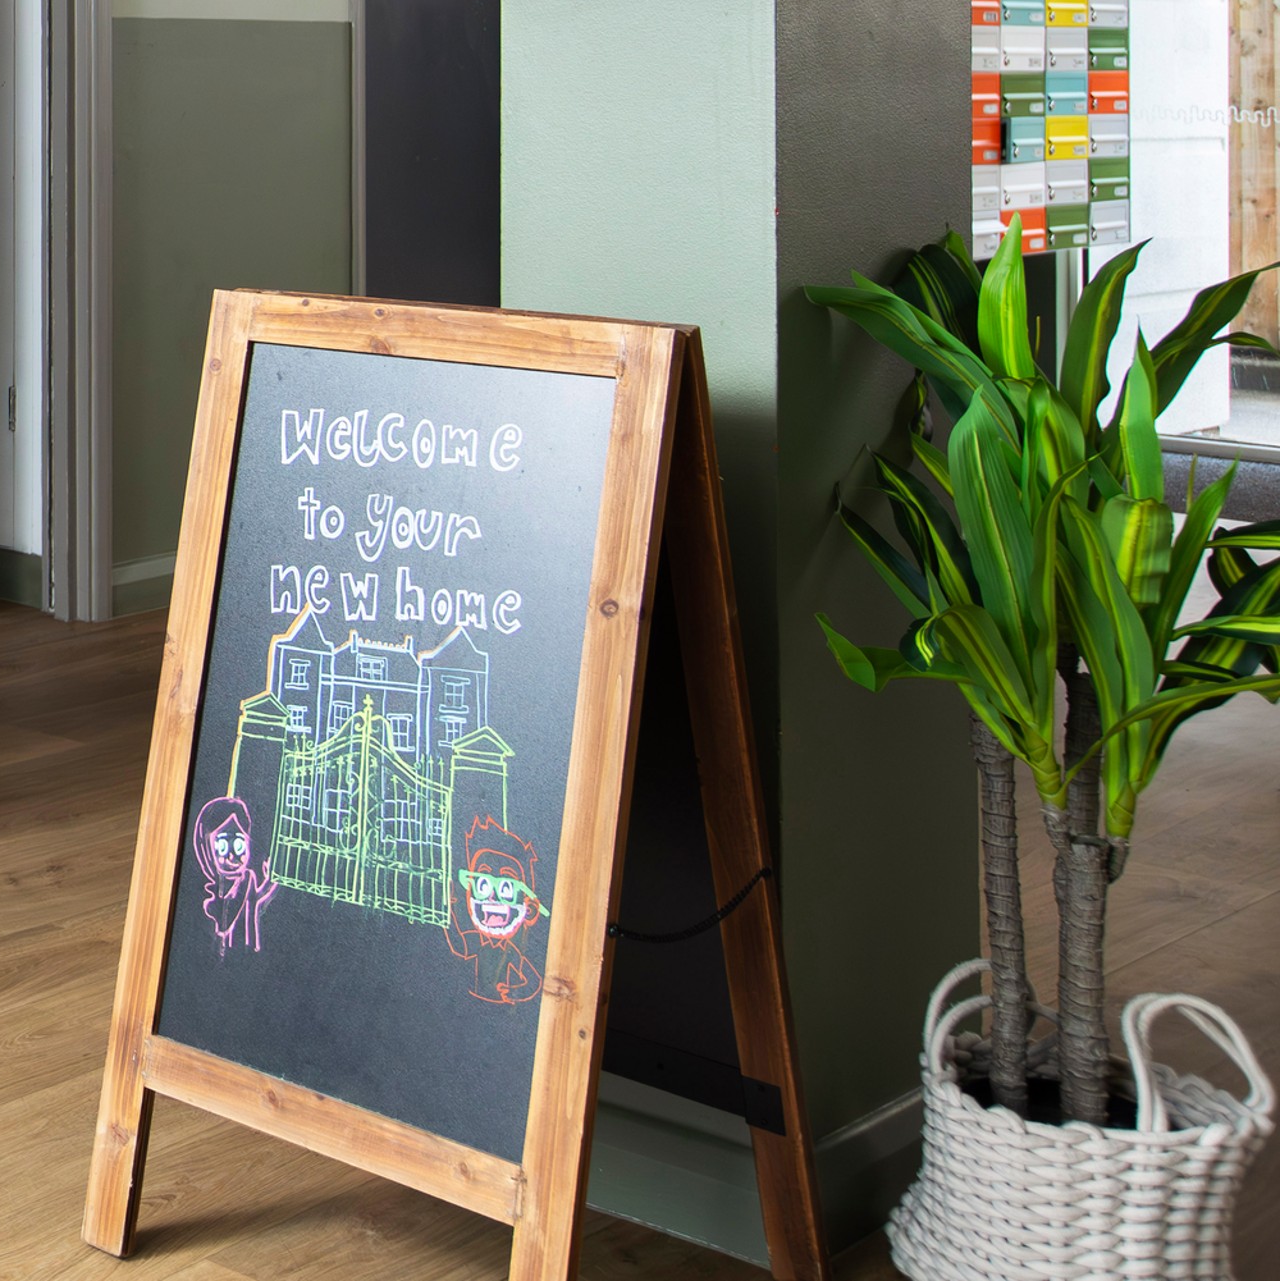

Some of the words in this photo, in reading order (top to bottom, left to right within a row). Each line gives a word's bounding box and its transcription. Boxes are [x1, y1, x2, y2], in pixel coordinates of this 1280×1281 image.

[297, 487, 344, 540] to
[355, 493, 482, 562] your
[270, 564, 378, 621] new
[395, 566, 521, 635] home
